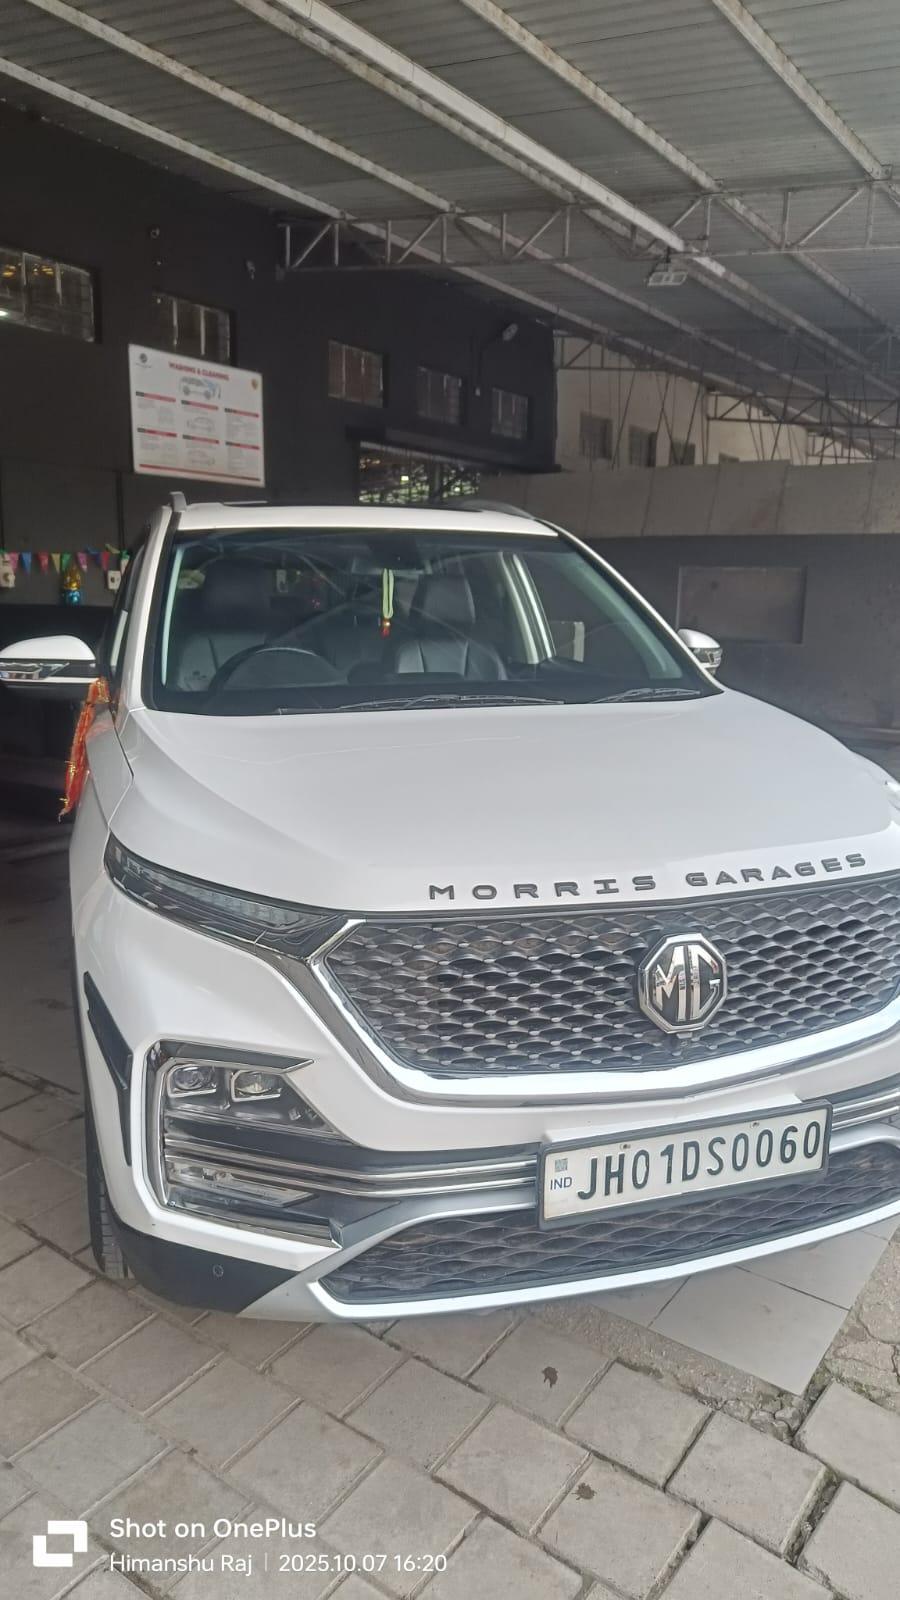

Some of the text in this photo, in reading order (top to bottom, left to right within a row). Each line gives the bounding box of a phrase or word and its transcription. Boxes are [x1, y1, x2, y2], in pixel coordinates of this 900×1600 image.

[428, 852, 867, 901] MORRIS GARAGES
[652, 944, 721, 1022] MG
[550, 1175, 573, 1191] IND
[577, 1120, 822, 1201] JH01DS0060
